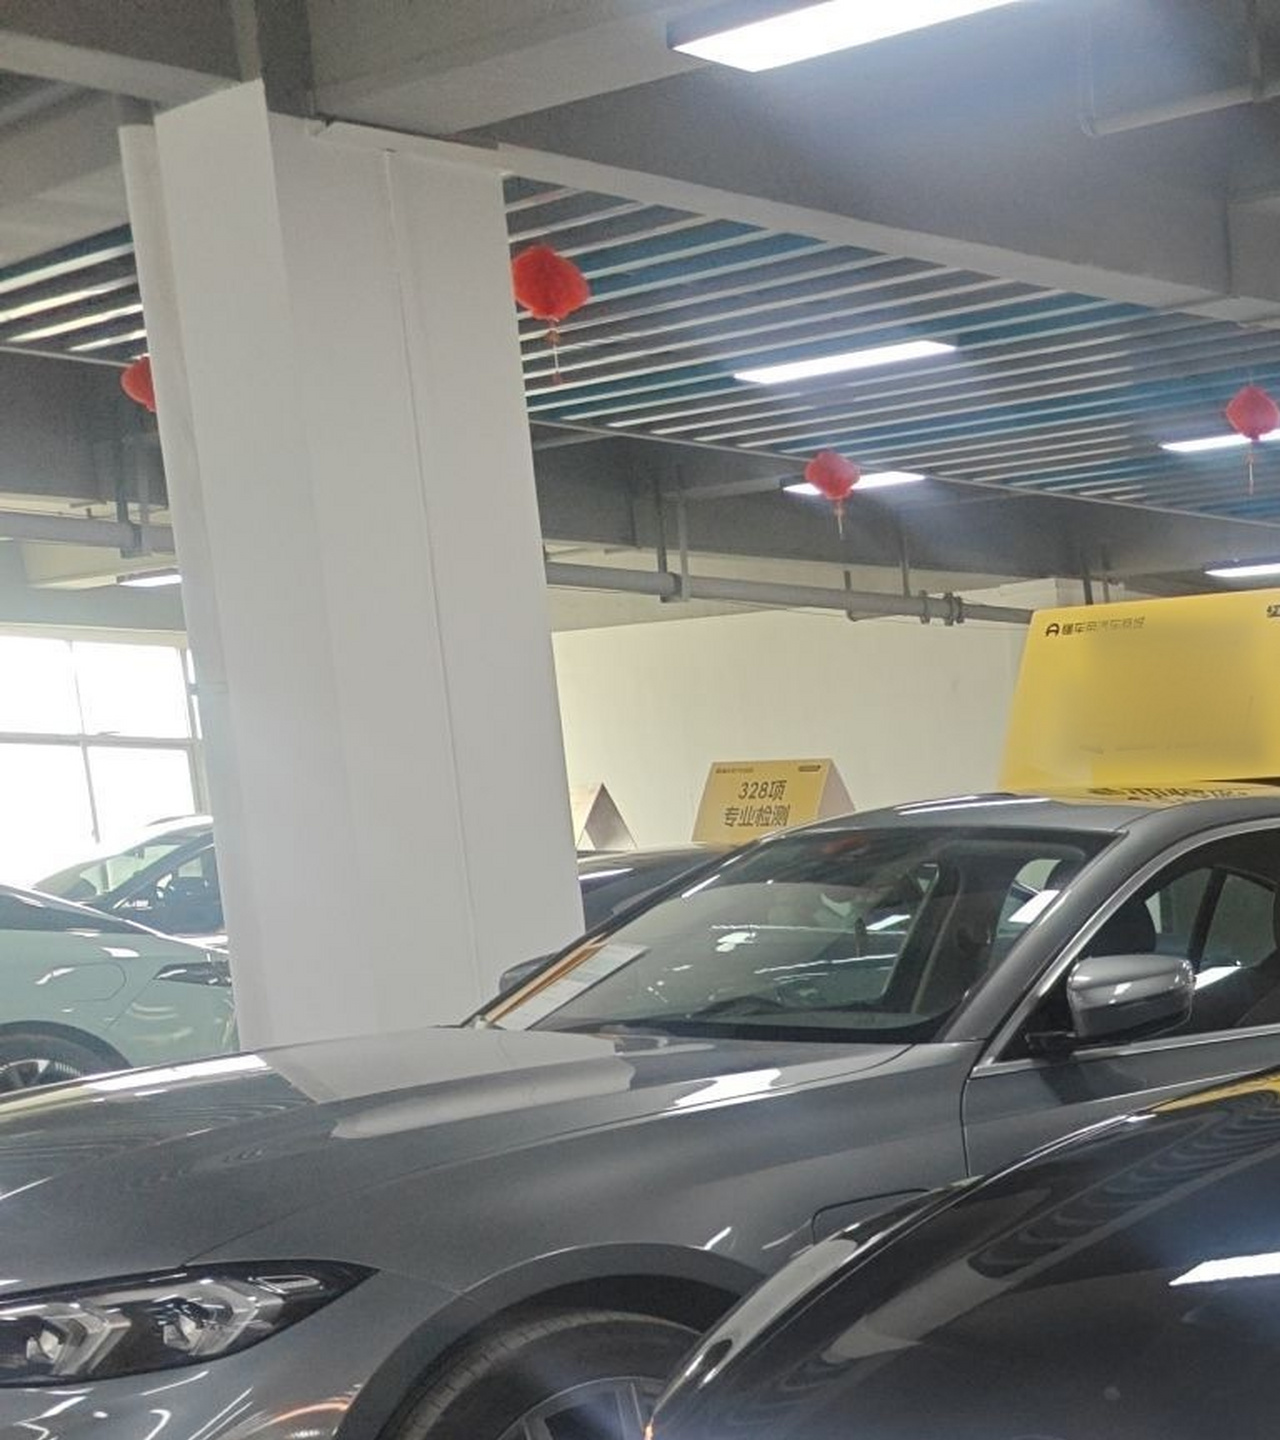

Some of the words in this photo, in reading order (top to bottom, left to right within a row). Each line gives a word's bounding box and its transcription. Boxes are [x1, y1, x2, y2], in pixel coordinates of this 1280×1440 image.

[738, 779, 787, 801] 328项
[723, 803, 791, 827] 专业检测
